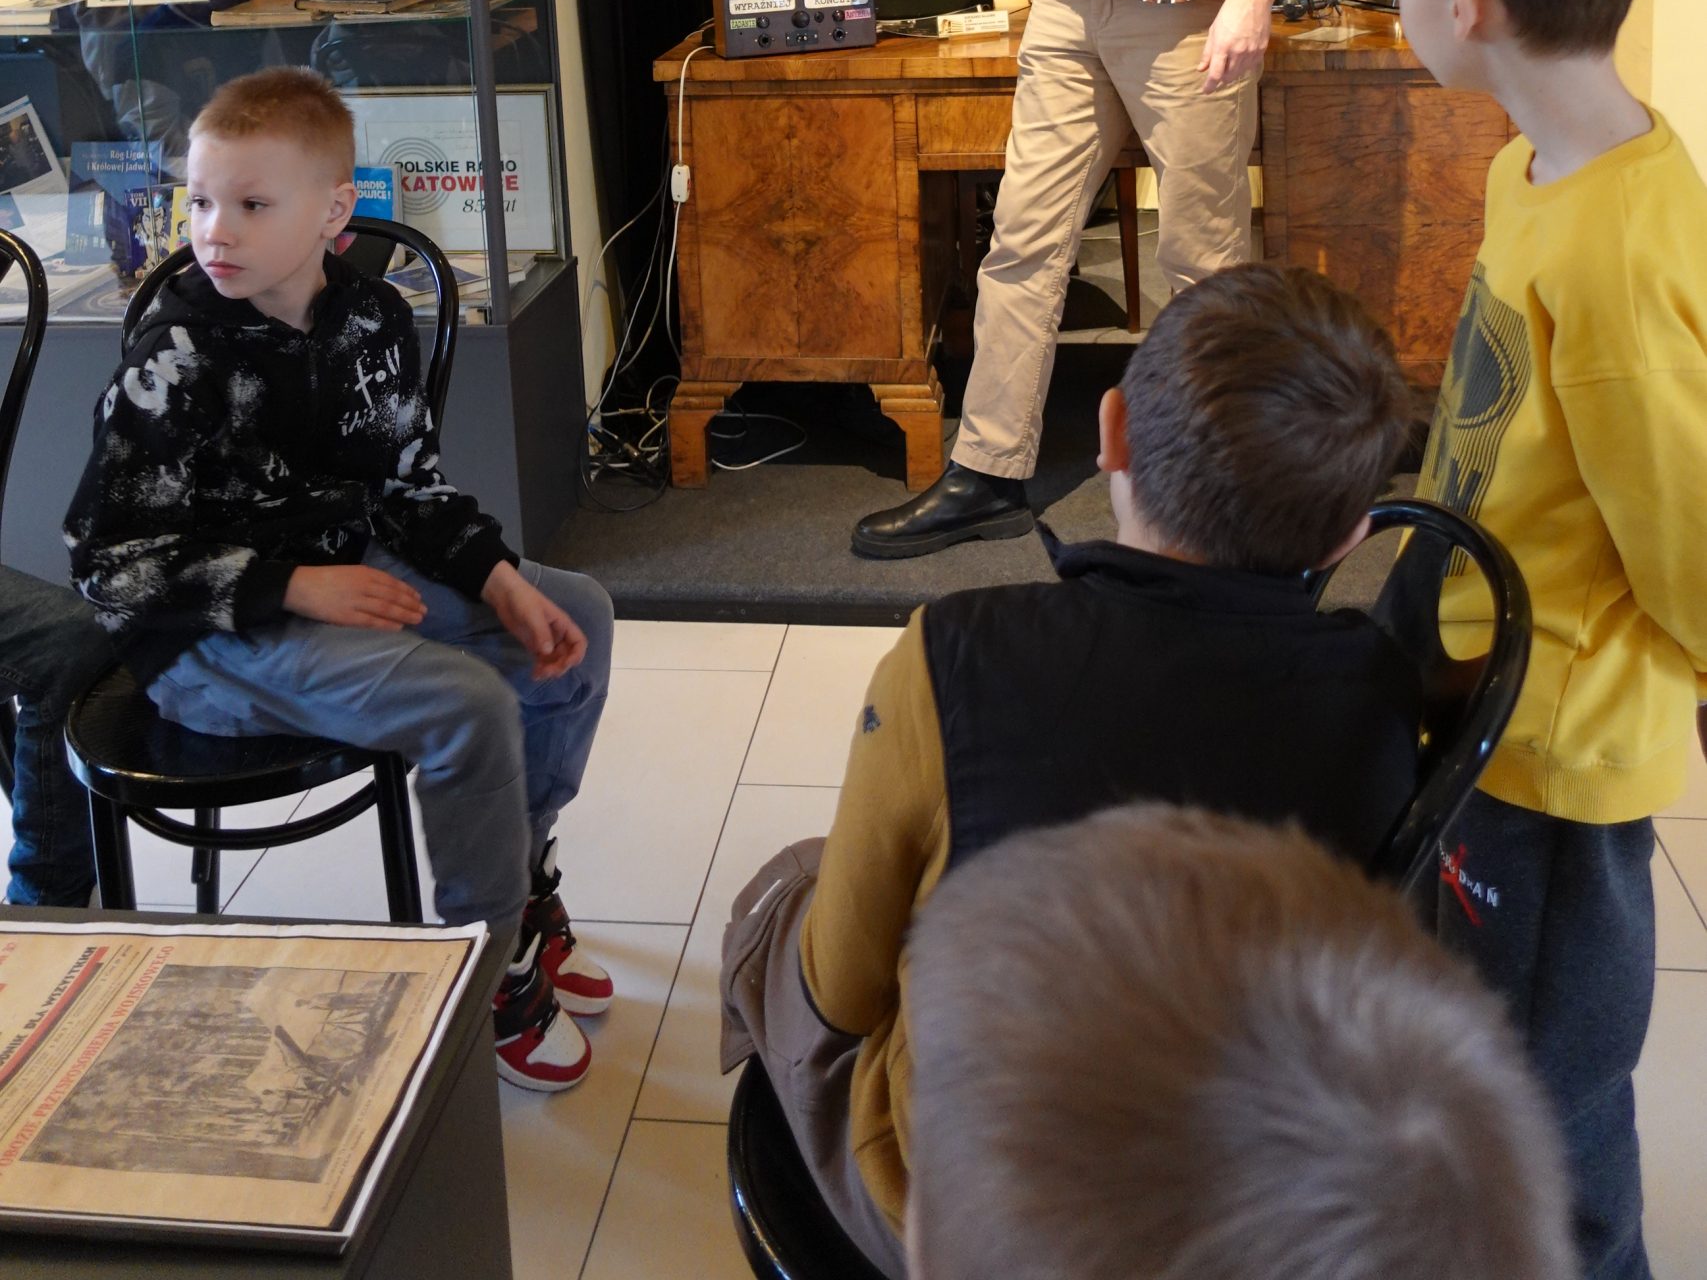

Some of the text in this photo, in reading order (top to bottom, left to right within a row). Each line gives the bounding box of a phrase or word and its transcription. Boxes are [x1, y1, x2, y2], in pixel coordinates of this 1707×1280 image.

[466, 160, 517, 172] RAIO
[400, 175, 519, 192] KATOWIE
[356, 190, 391, 200] OWICE!
[130, 197, 148, 207] VII
